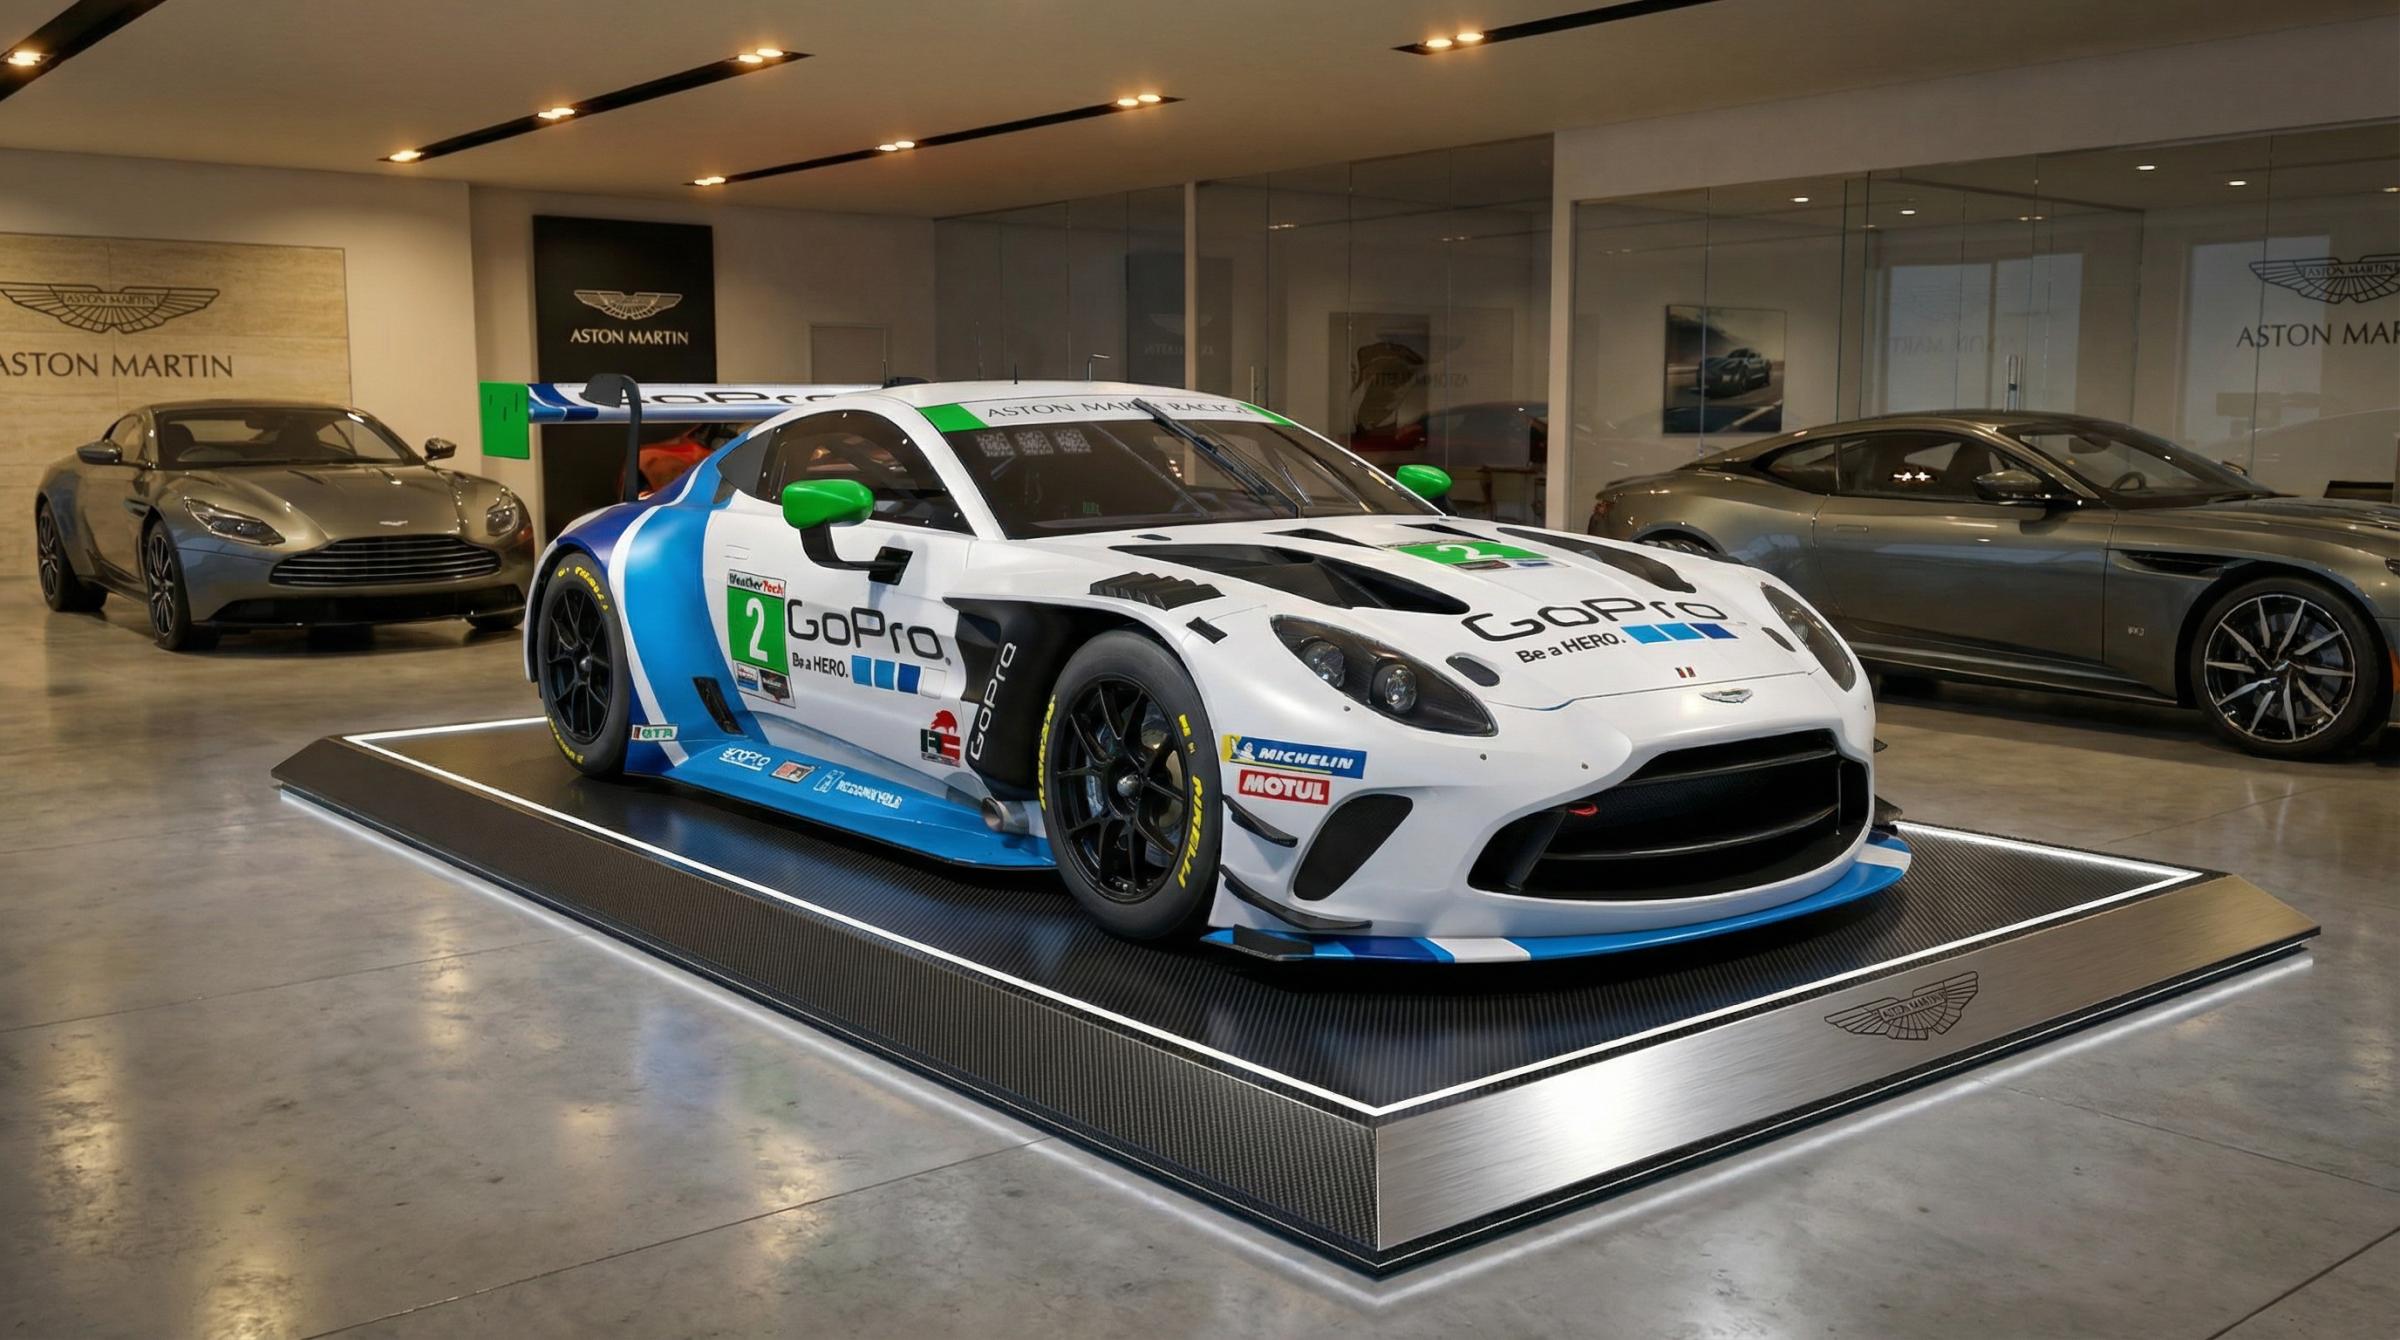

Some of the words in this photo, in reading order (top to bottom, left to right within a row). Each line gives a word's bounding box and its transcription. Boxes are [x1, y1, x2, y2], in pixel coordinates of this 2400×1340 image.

[570, 328, 624, 344] ASTON
[628, 330, 689, 345] MARTIN
[2236, 323, 2332, 348] ASTON
[112, 354, 232, 377] MARTIN
[988, 404, 1076, 418] ASTON
[1436, 544, 1503, 560] 2
[746, 597, 768, 662] 2
[1461, 597, 1728, 641] GoPro
[1515, 650, 1547, 663] Be
[1548, 646, 1562, 656] a
[1560, 632, 1626, 653] HERO.
[805, 659, 811, 670] a
[814, 656, 848, 678] HERO.
[970, 642, 1017, 761] GoPro
[1258, 748, 1354, 769] MICHELIN
[1242, 774, 1325, 801] MOTUL
